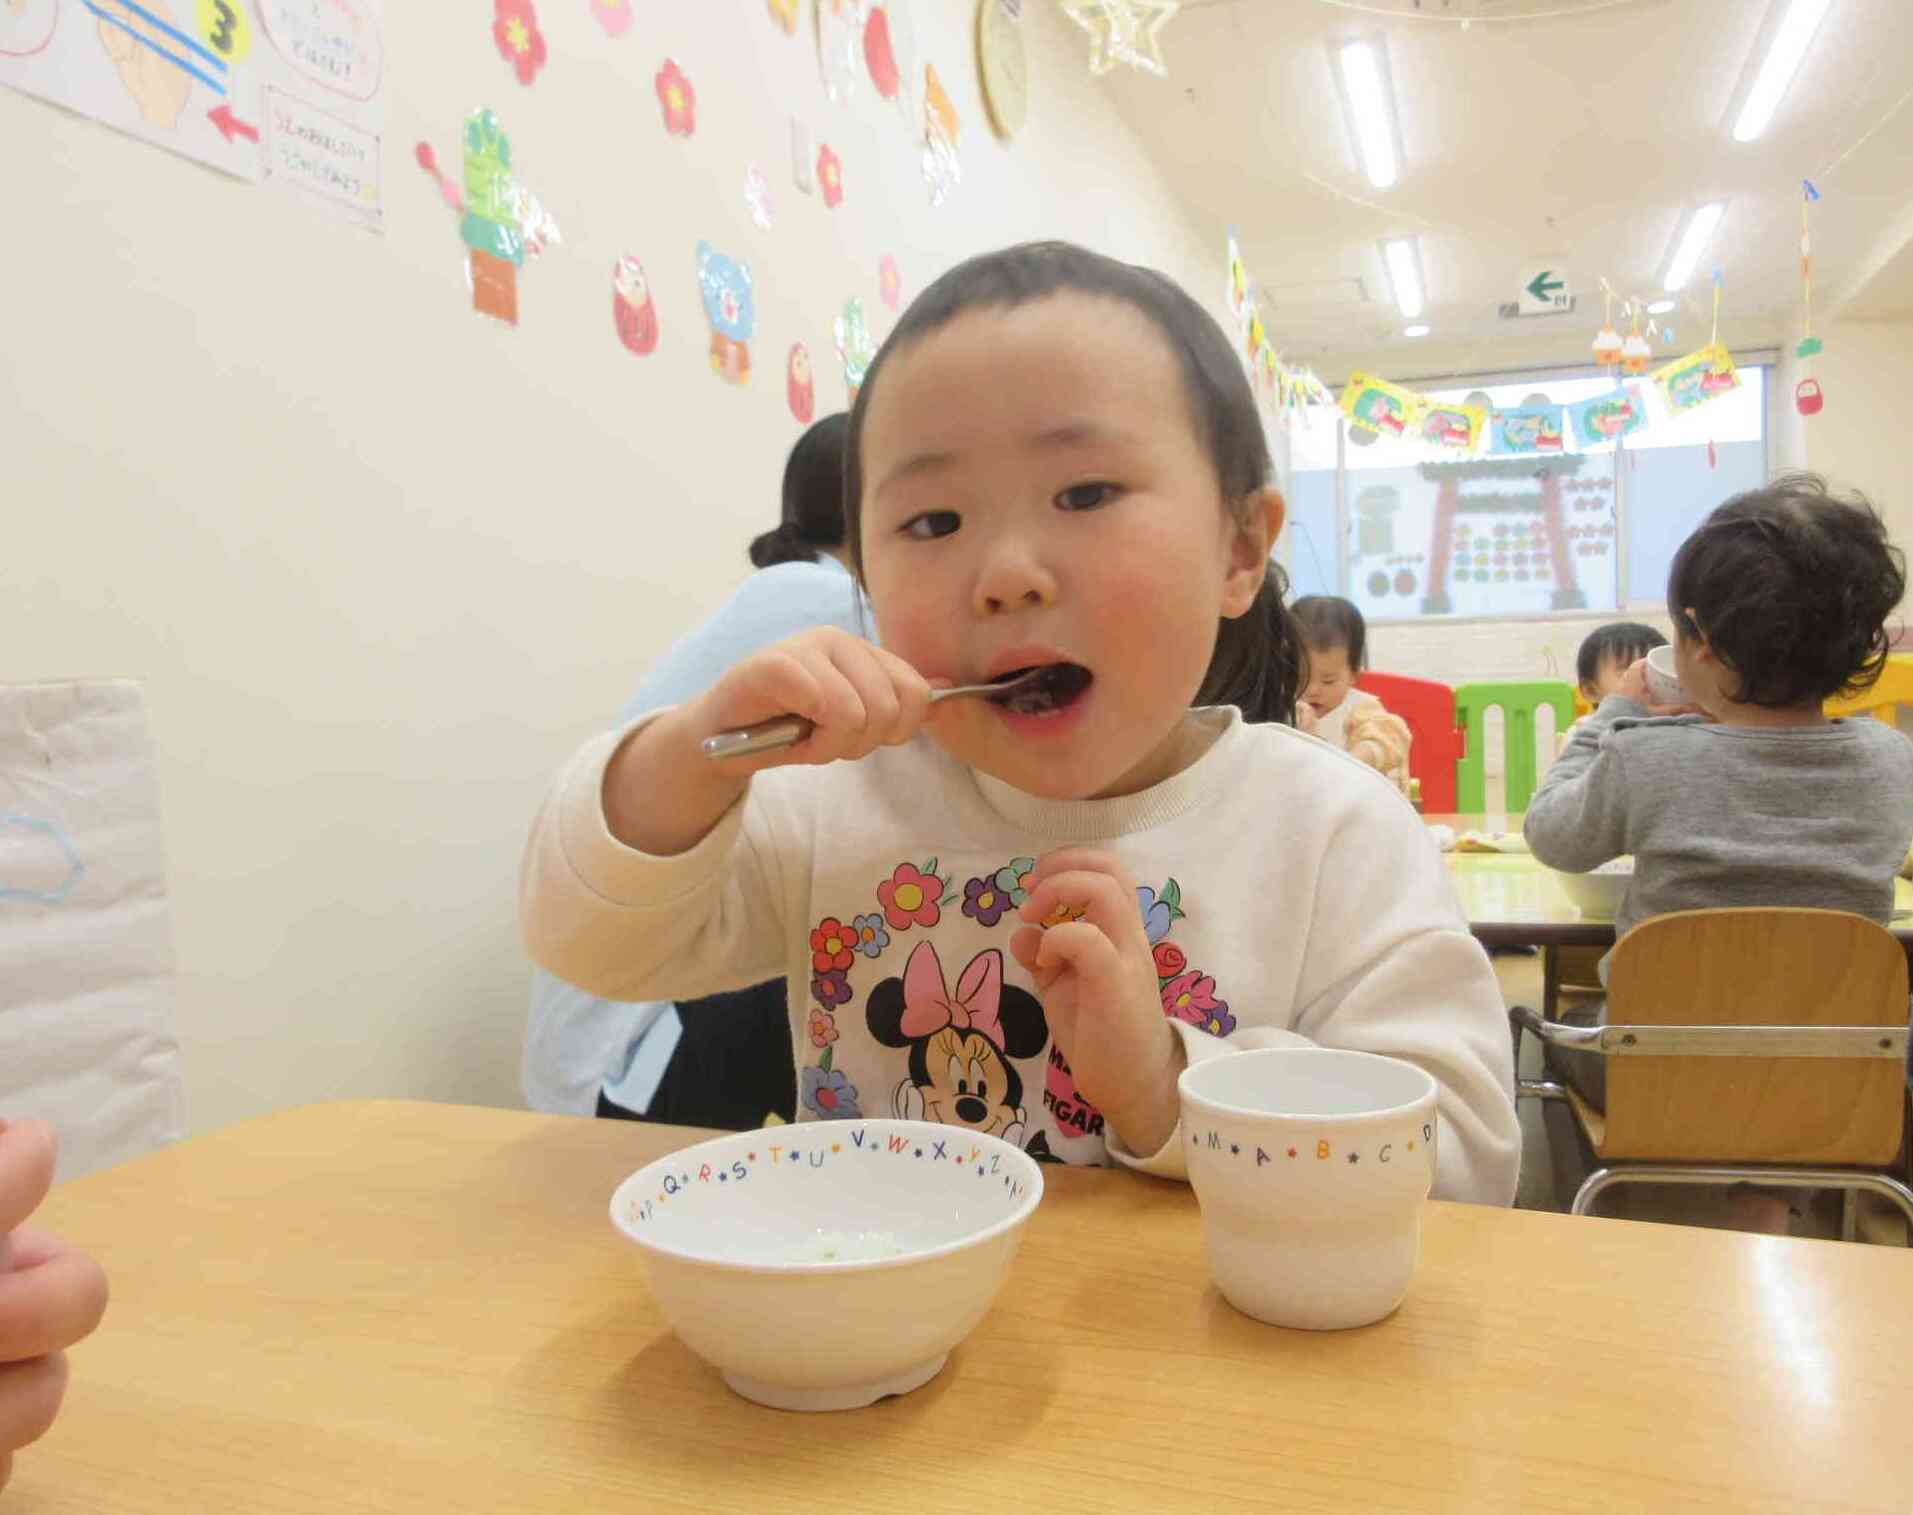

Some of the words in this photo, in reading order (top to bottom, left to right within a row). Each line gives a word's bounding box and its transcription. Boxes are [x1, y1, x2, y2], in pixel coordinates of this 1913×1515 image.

[663, 1175, 681, 1194] Q
[698, 1162, 712, 1183] R
[732, 1161, 747, 1180] S
[768, 1146, 784, 1167] T
[809, 1150, 825, 1168] U
[851, 1129, 865, 1148] V
[887, 1134, 909, 1154] W
[932, 1140, 947, 1161] X
[991, 1154, 1001, 1174] Z
[1207, 1131, 1221, 1150] M
[1256, 1147, 1271, 1167] A
[1317, 1139, 1330, 1160] B
[1379, 1144, 1392, 1163] C
[1422, 1123, 1432, 1143] D
